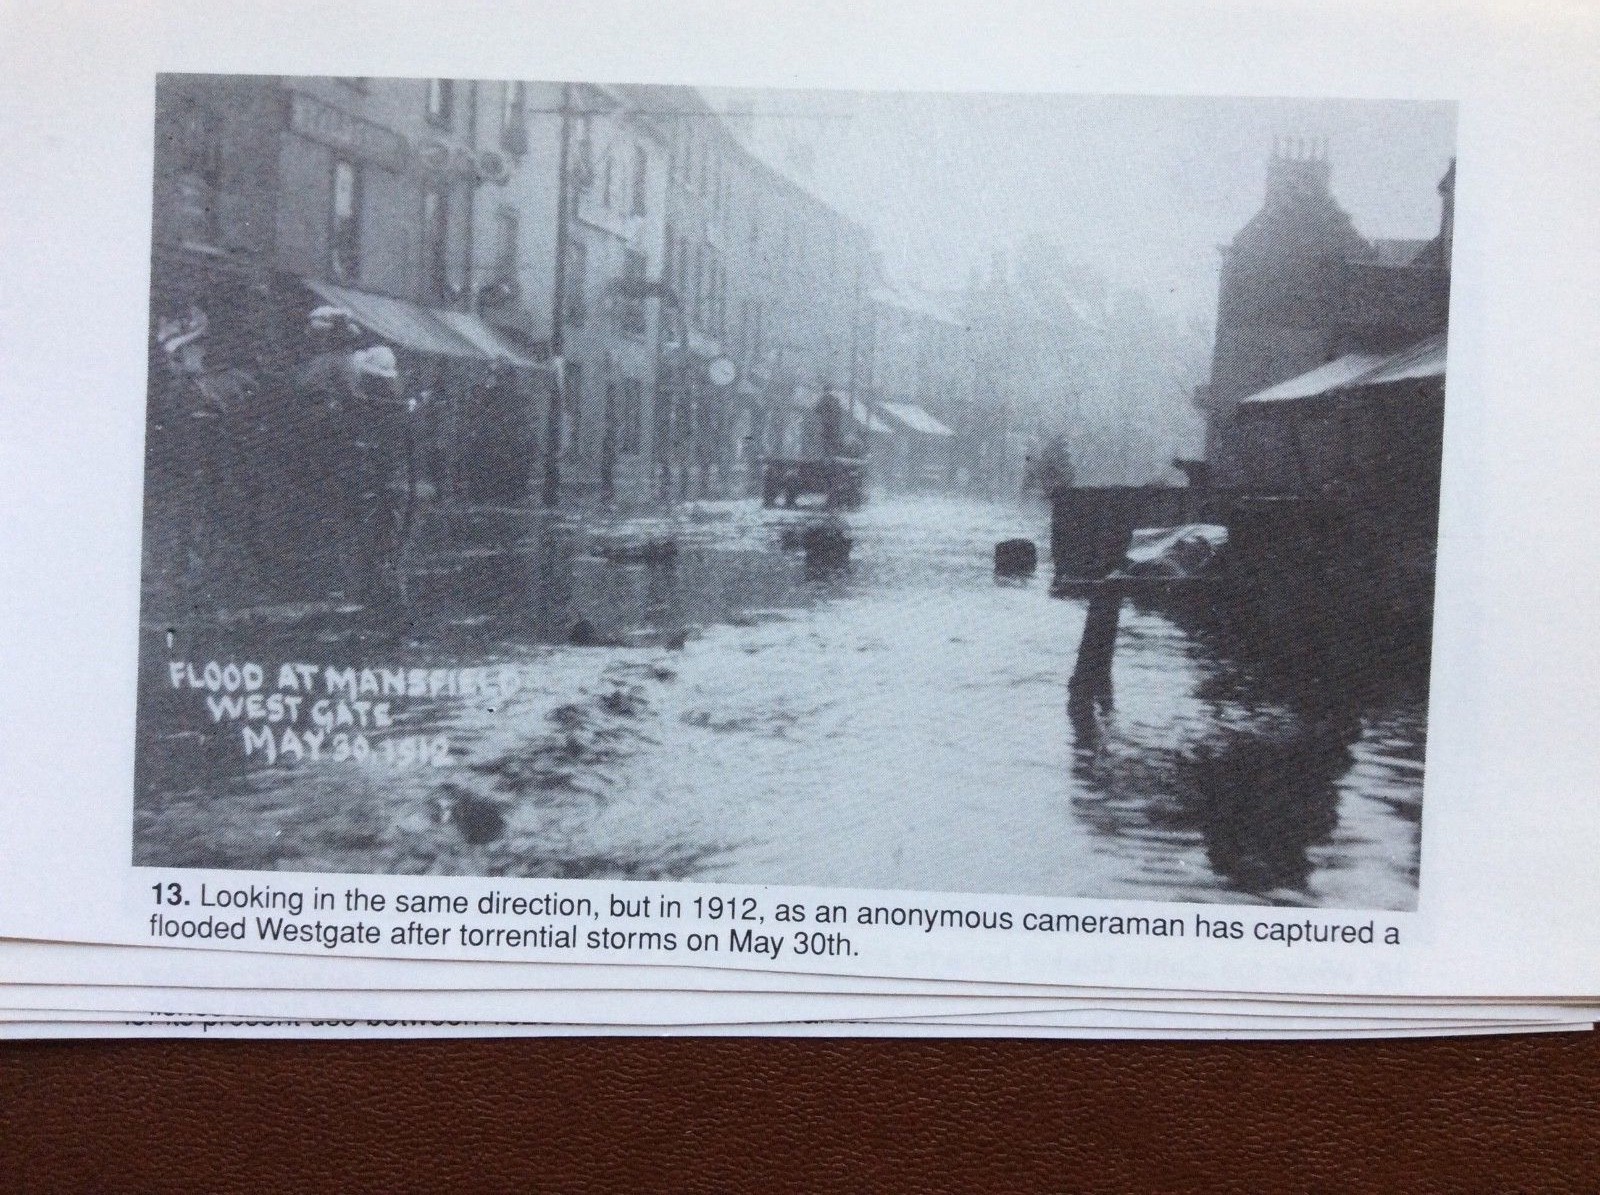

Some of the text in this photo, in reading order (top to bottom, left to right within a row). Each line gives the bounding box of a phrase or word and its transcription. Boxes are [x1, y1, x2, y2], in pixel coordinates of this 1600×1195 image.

[169, 660, 523, 701] FLOOD AT MANSFIELD
[206, 693, 392, 733] WEST GATE
[242, 725, 326, 765] MAY
[152, 883, 1400, 947] 13. Looking in the same direction, but in 1912, as an anonymous cameraman has captured a
[150, 914, 859, 960] flooded Westgate after torrential storms on May 30th.
